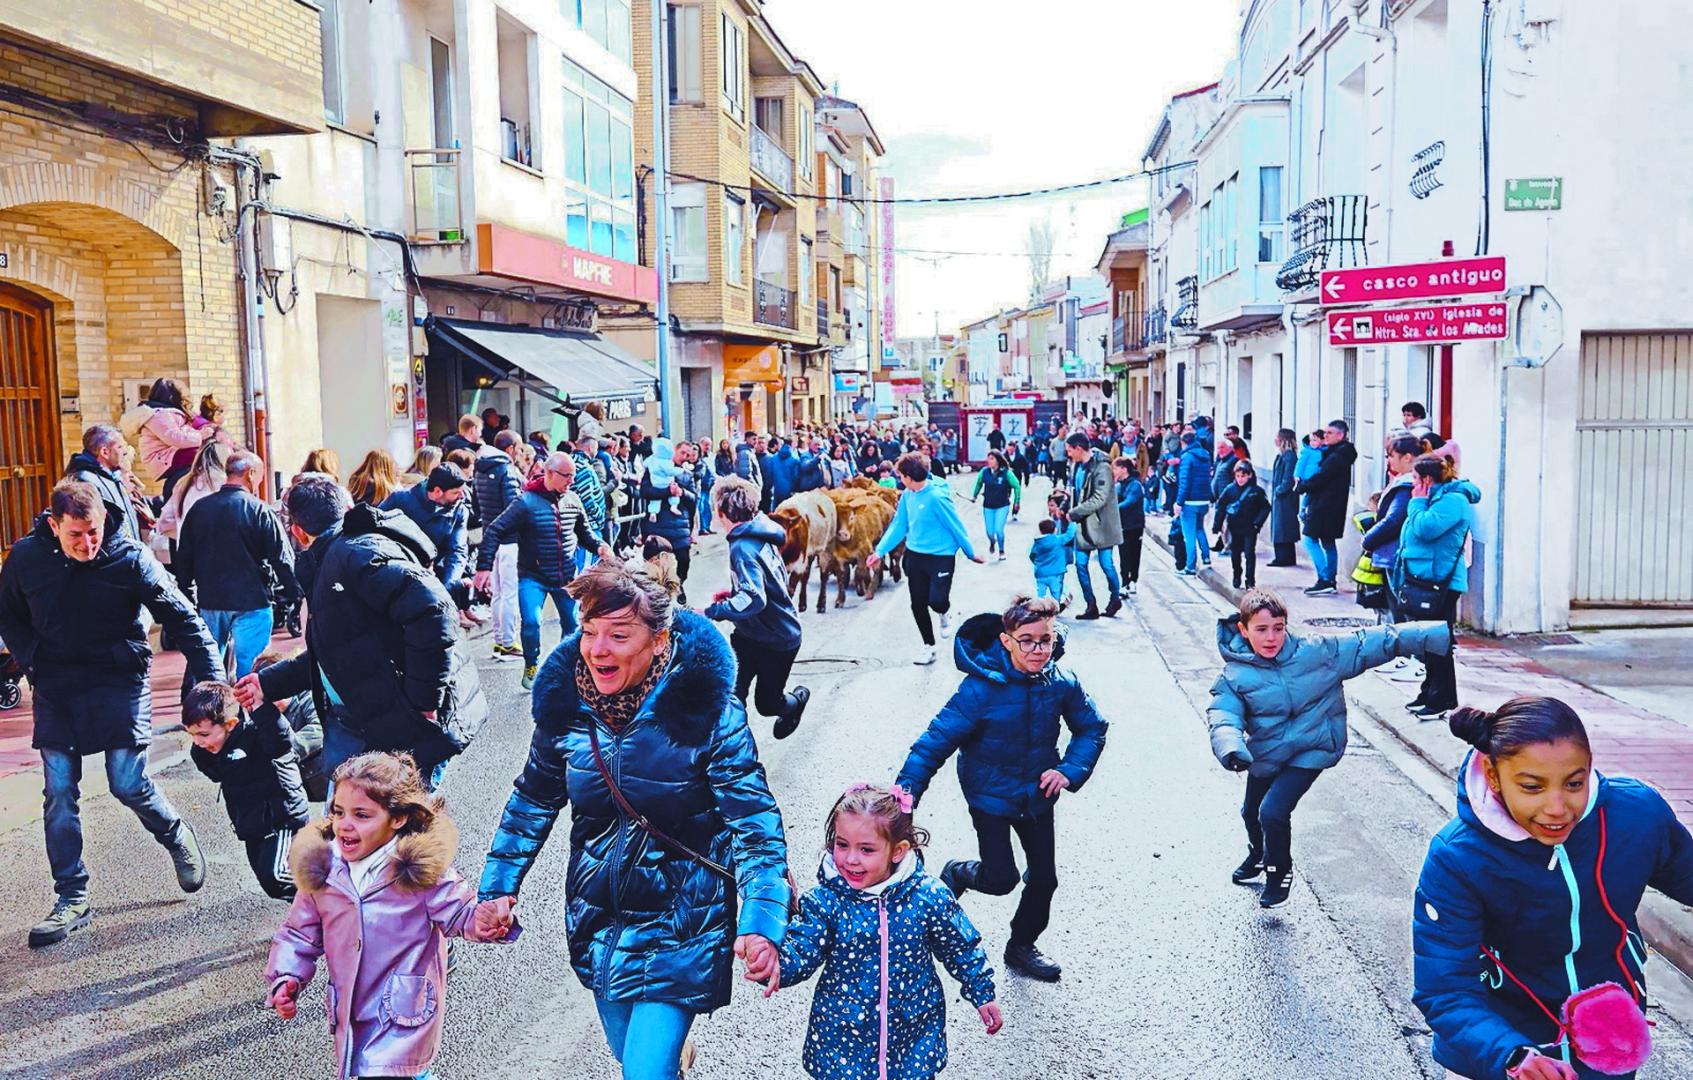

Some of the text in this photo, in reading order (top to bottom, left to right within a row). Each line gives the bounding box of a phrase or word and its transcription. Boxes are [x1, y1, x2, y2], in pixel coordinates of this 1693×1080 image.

[573, 256, 612, 286] MAPFRE
[1363, 268, 1503, 290] casco antiguo
[1384, 312, 1410, 323] (siglo
[1413, 310, 1434, 321] XVI)
[1488, 305, 1504, 317] de
[1375, 326, 1399, 339] Ntra.
[1402, 324, 1422, 339] Sra.
[1442, 323, 1458, 337] los
